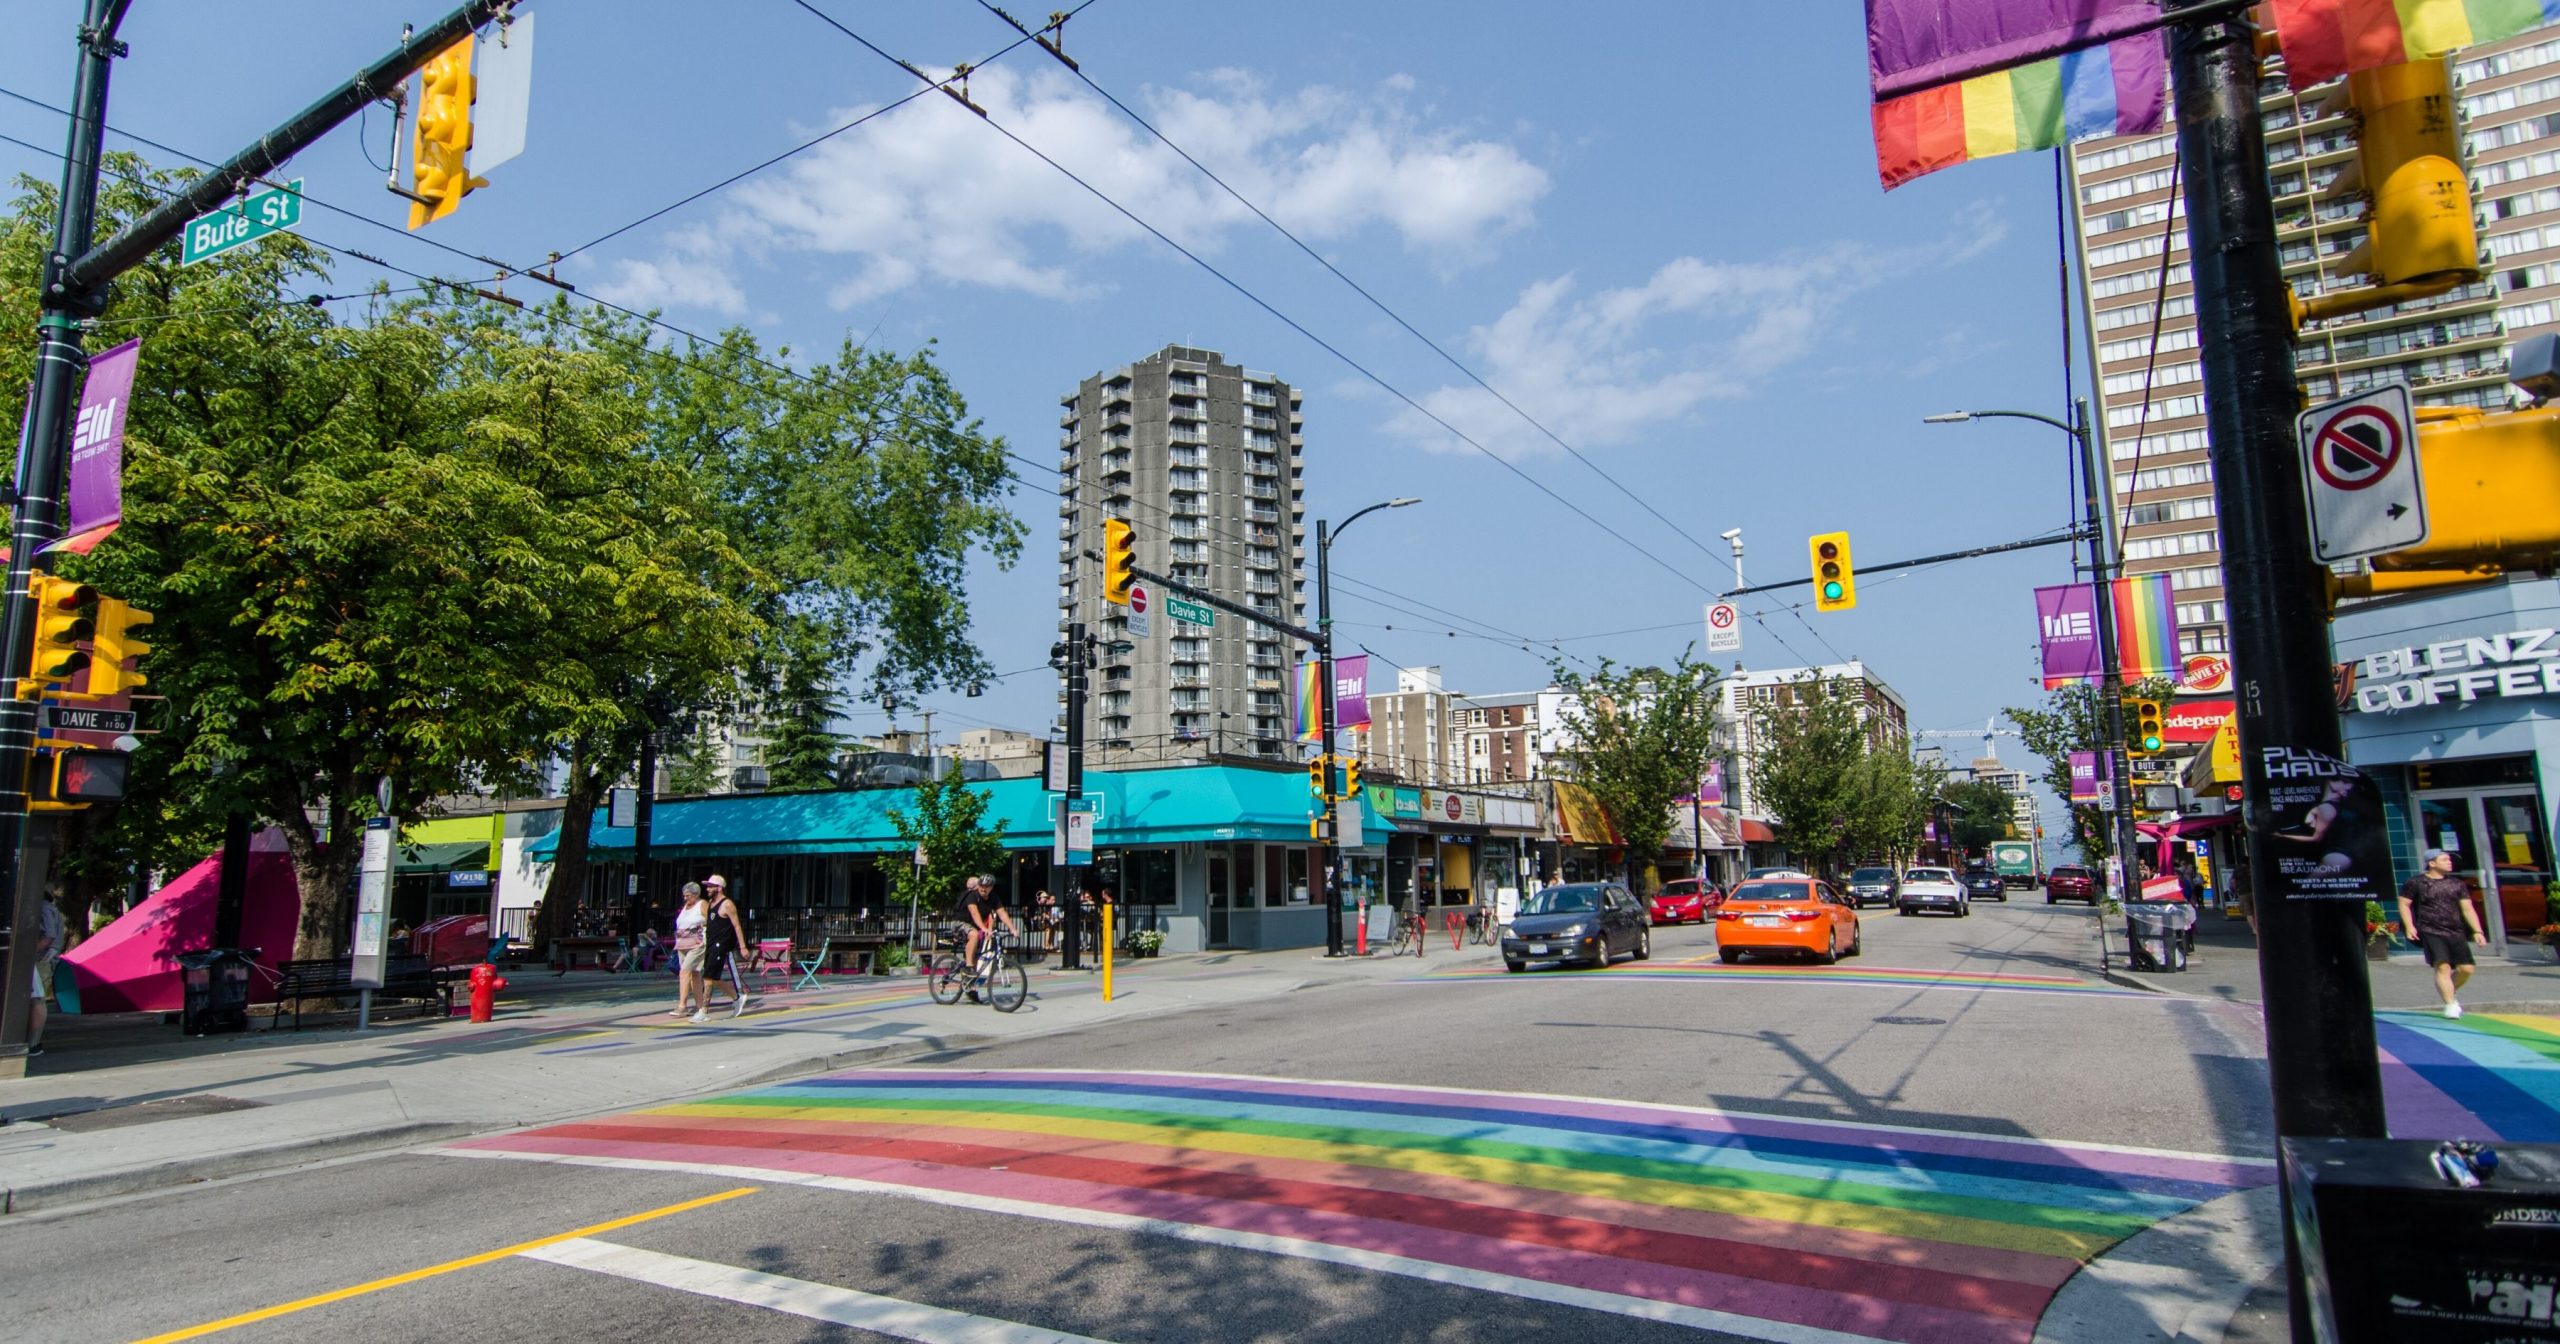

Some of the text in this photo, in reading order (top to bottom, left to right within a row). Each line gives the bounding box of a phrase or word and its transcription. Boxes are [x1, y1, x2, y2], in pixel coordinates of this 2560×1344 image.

[193, 193, 289, 254] Bute St
[1170, 601, 1210, 624] Davie St
[1712, 632, 1735, 640] EXCEPT
[2060, 635, 2078, 643] WEST
[1711, 639, 1738, 648] BICYCLES
[2365, 628, 2560, 680] BLENZ
[2183, 661, 2227, 686] DAVIE ST
[61, 711, 98, 727] DAVIE
[105, 721, 126, 729] 1100
[2137, 762, 2156, 770] BUTE
[2266, 759, 2360, 778] HAUS
[2270, 796, 2285, 804] DANCE
[2294, 795, 2316, 803] DUNGEON
[2271, 804, 2284, 812] PARTY
[2285, 865, 2341, 873] BEAUMONT
[2437, 1311, 2457, 1319] NEWS
[2458, 1312, 2465, 1320] &
[2465, 1312, 2522, 1325] ENTERTAINMENT
[2522, 1318, 2551, 1329] WEEKLY
